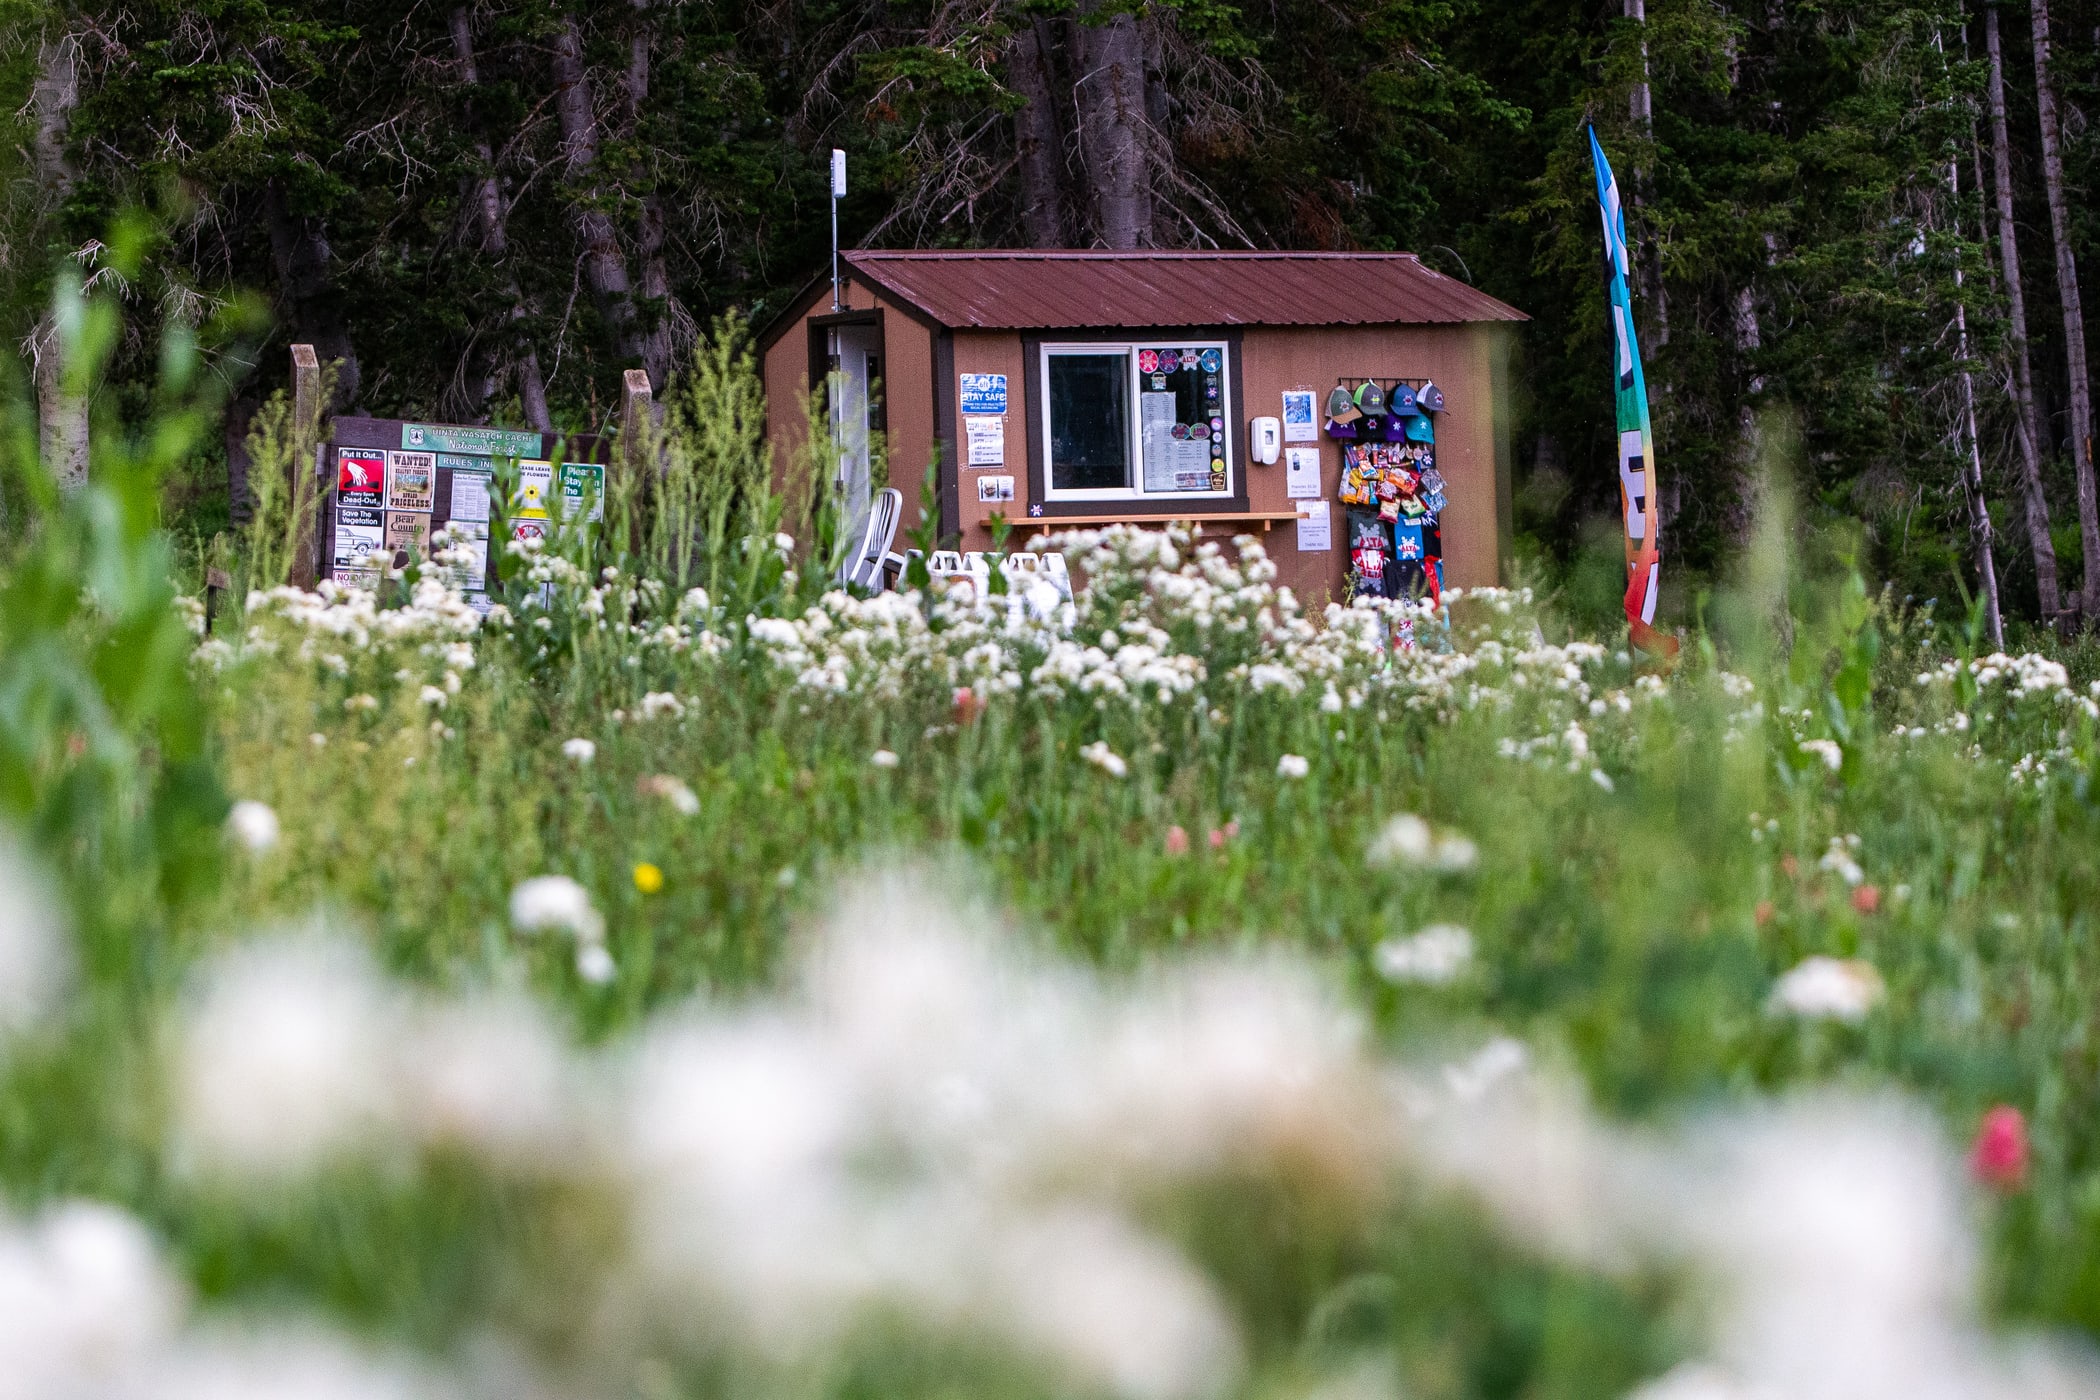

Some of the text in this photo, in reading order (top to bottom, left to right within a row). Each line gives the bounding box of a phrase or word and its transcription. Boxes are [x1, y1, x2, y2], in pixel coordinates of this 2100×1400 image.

[962, 392, 1005, 401] STAY SAFE
[462, 430, 503, 440] WASATCH
[506, 432, 535, 442] CACHE
[449, 439, 488, 451] National
[342, 450, 355, 458] Put
[394, 455, 432, 467] WANTED!
[443, 457, 473, 466] RULES
[564, 476, 582, 487] Stay
[563, 486, 578, 496] The
[342, 517, 378, 525] Vegetation
[395, 514, 416, 523] Bear
[391, 522, 426, 532] County
[1359, 536, 1384, 548] ALTA
[337, 573, 350, 581] NO
